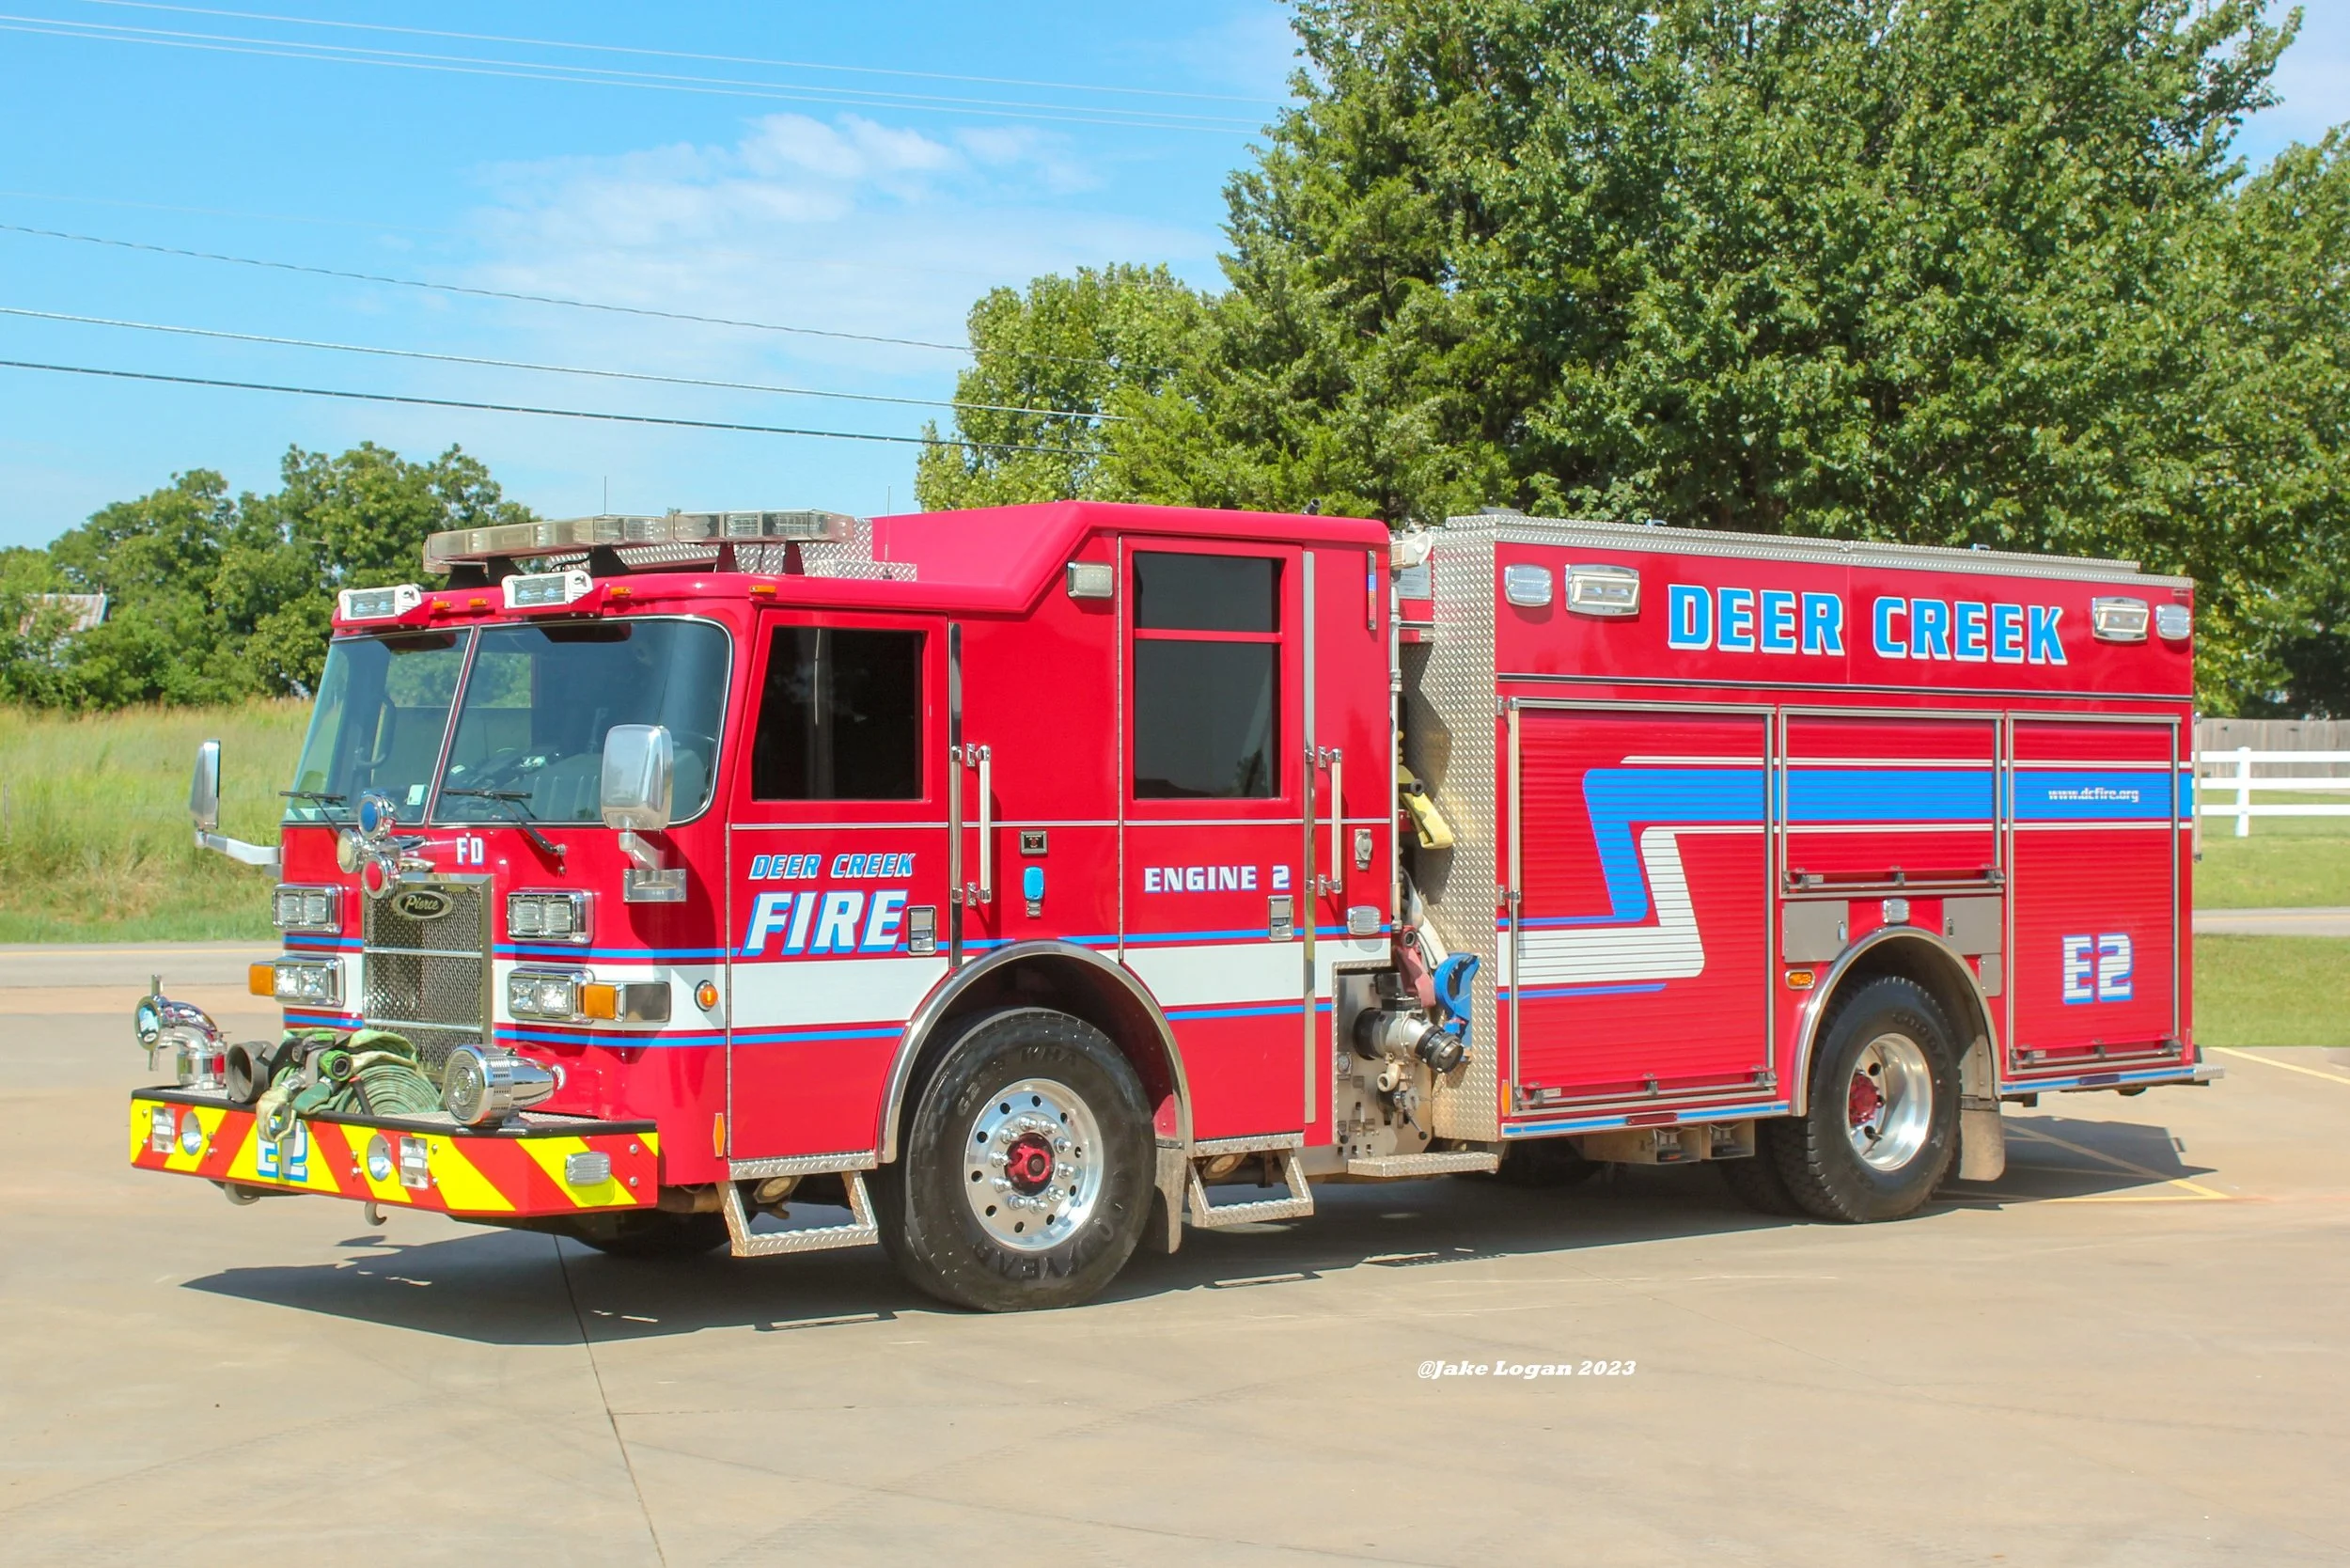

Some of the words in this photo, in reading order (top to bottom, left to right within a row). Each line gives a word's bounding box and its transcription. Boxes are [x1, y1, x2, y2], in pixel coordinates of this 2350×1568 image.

[1667, 584, 1845, 656] DEER
[1873, 596, 2068, 665] CREEK
[2048, 787, 2139, 803] www.dcfire.org
[456, 837, 484, 865] FD
[748, 855, 821, 880] DEER
[830, 854, 916, 878] CREEK
[1144, 865, 1257, 893] ENGINE
[1272, 865, 1290, 890] 2
[404, 895, 440, 911] Pierce
[741, 890, 908, 956] FIRE
[2062, 933, 2134, 1005] E2
